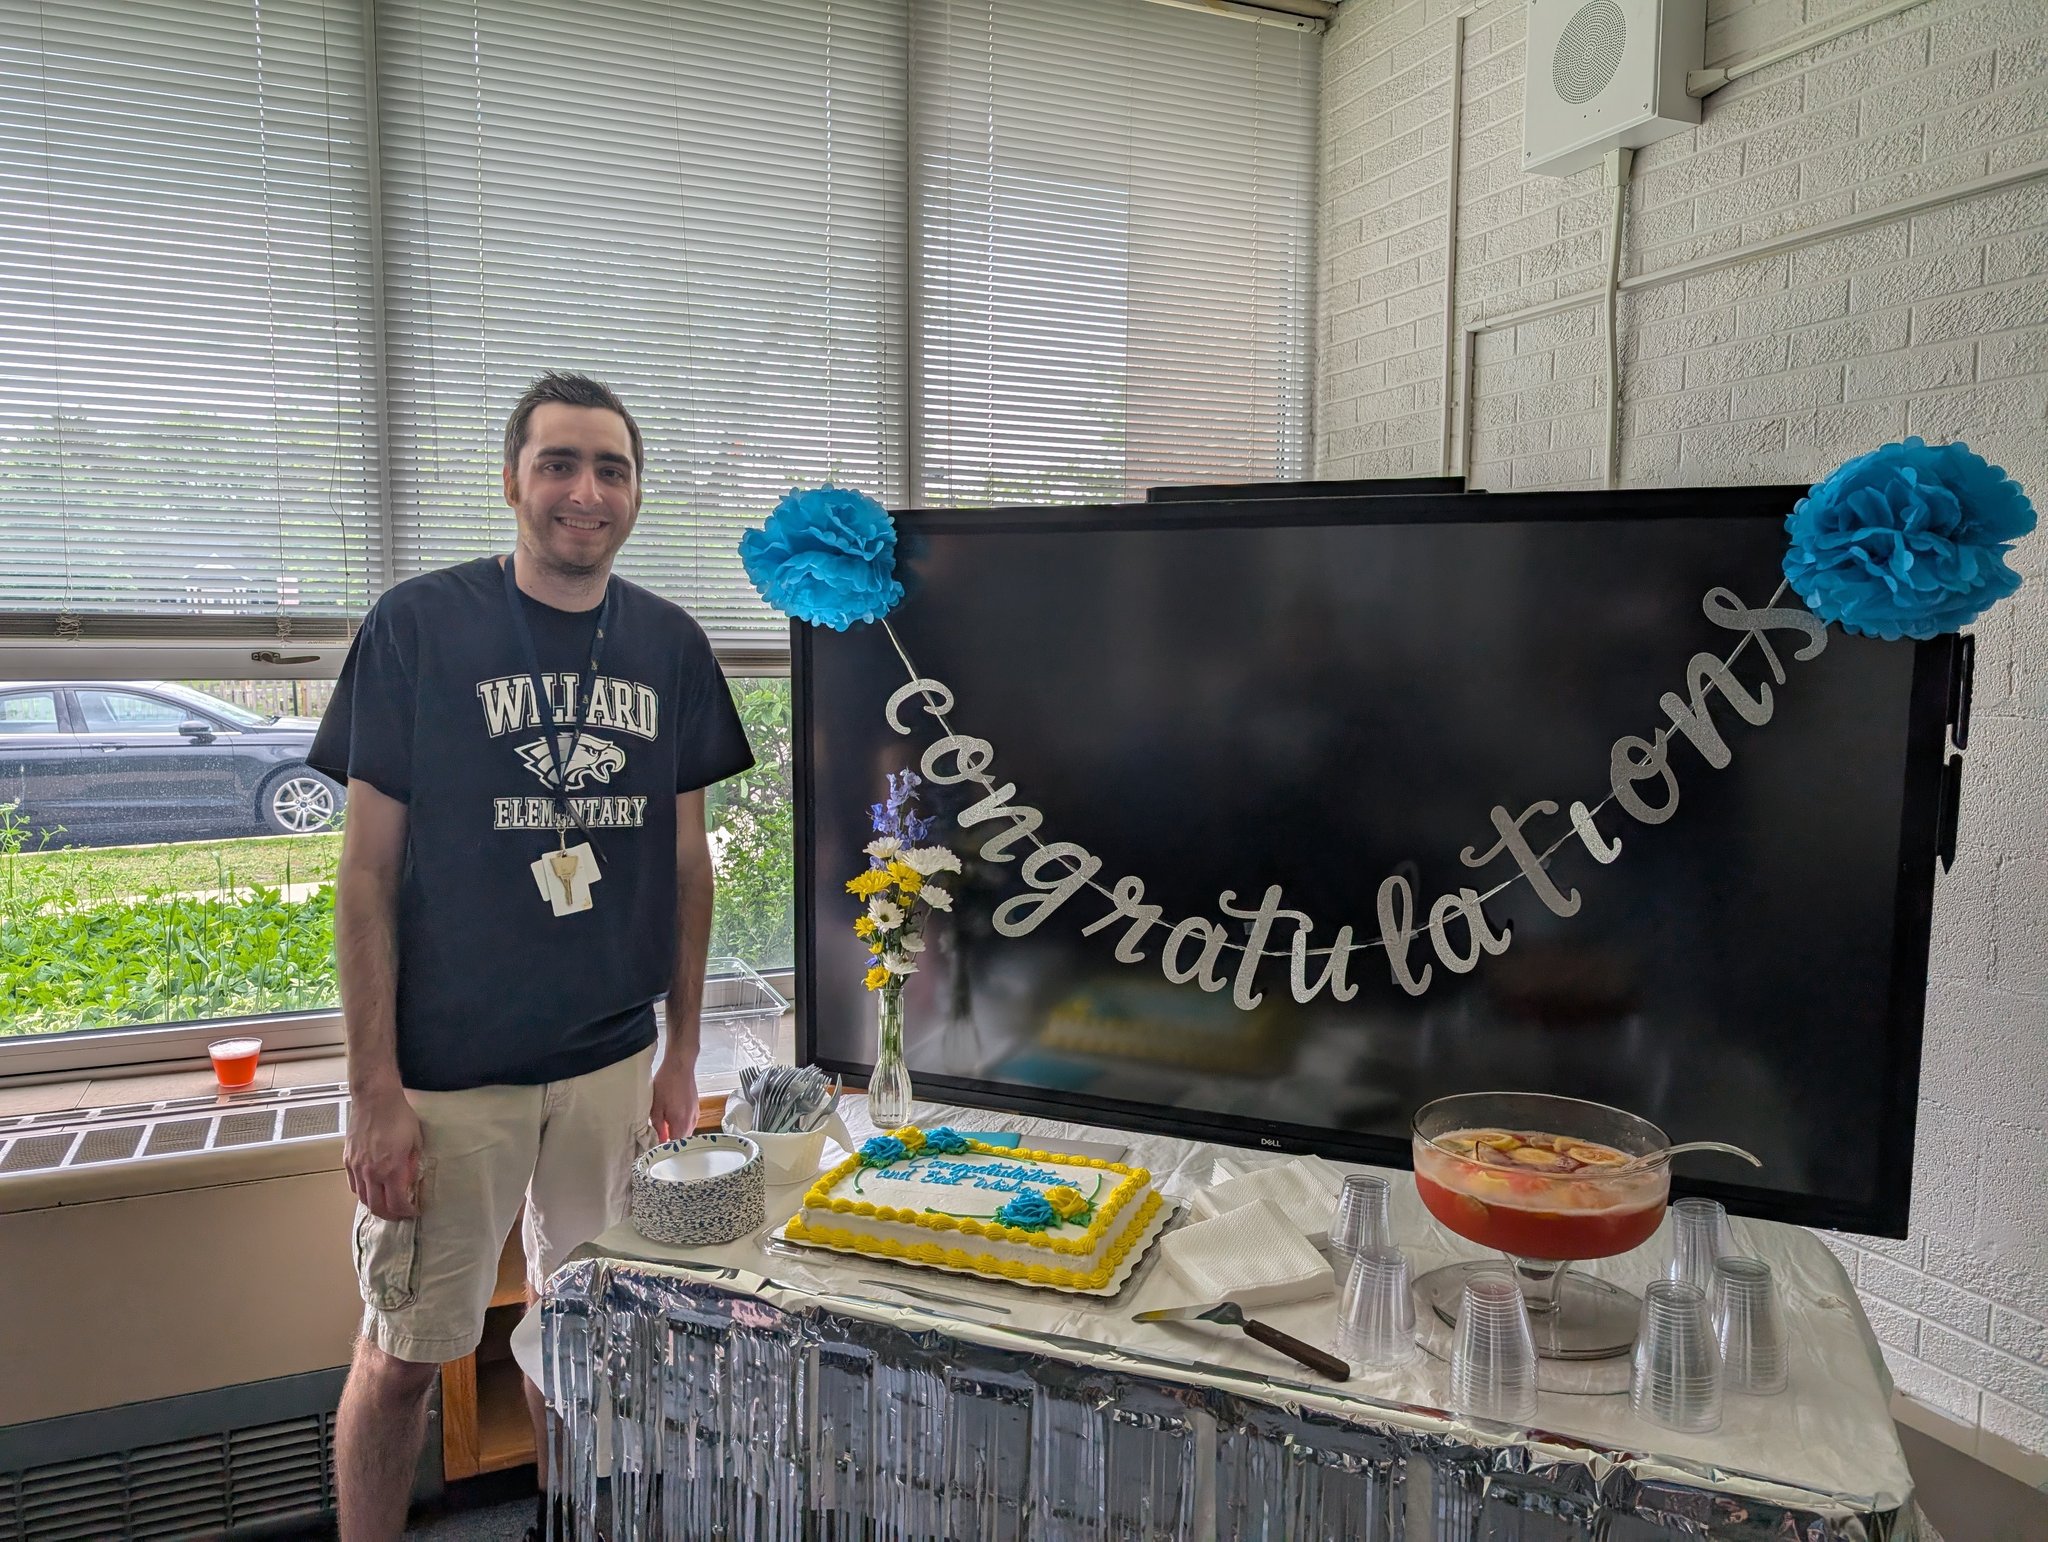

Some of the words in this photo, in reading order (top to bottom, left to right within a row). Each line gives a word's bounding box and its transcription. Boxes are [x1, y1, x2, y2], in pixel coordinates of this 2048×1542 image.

[494, 796, 648, 830] ELEMNTARY
[1260, 1138, 1282, 1148] DELL
[876, 1168, 917, 1181] and
